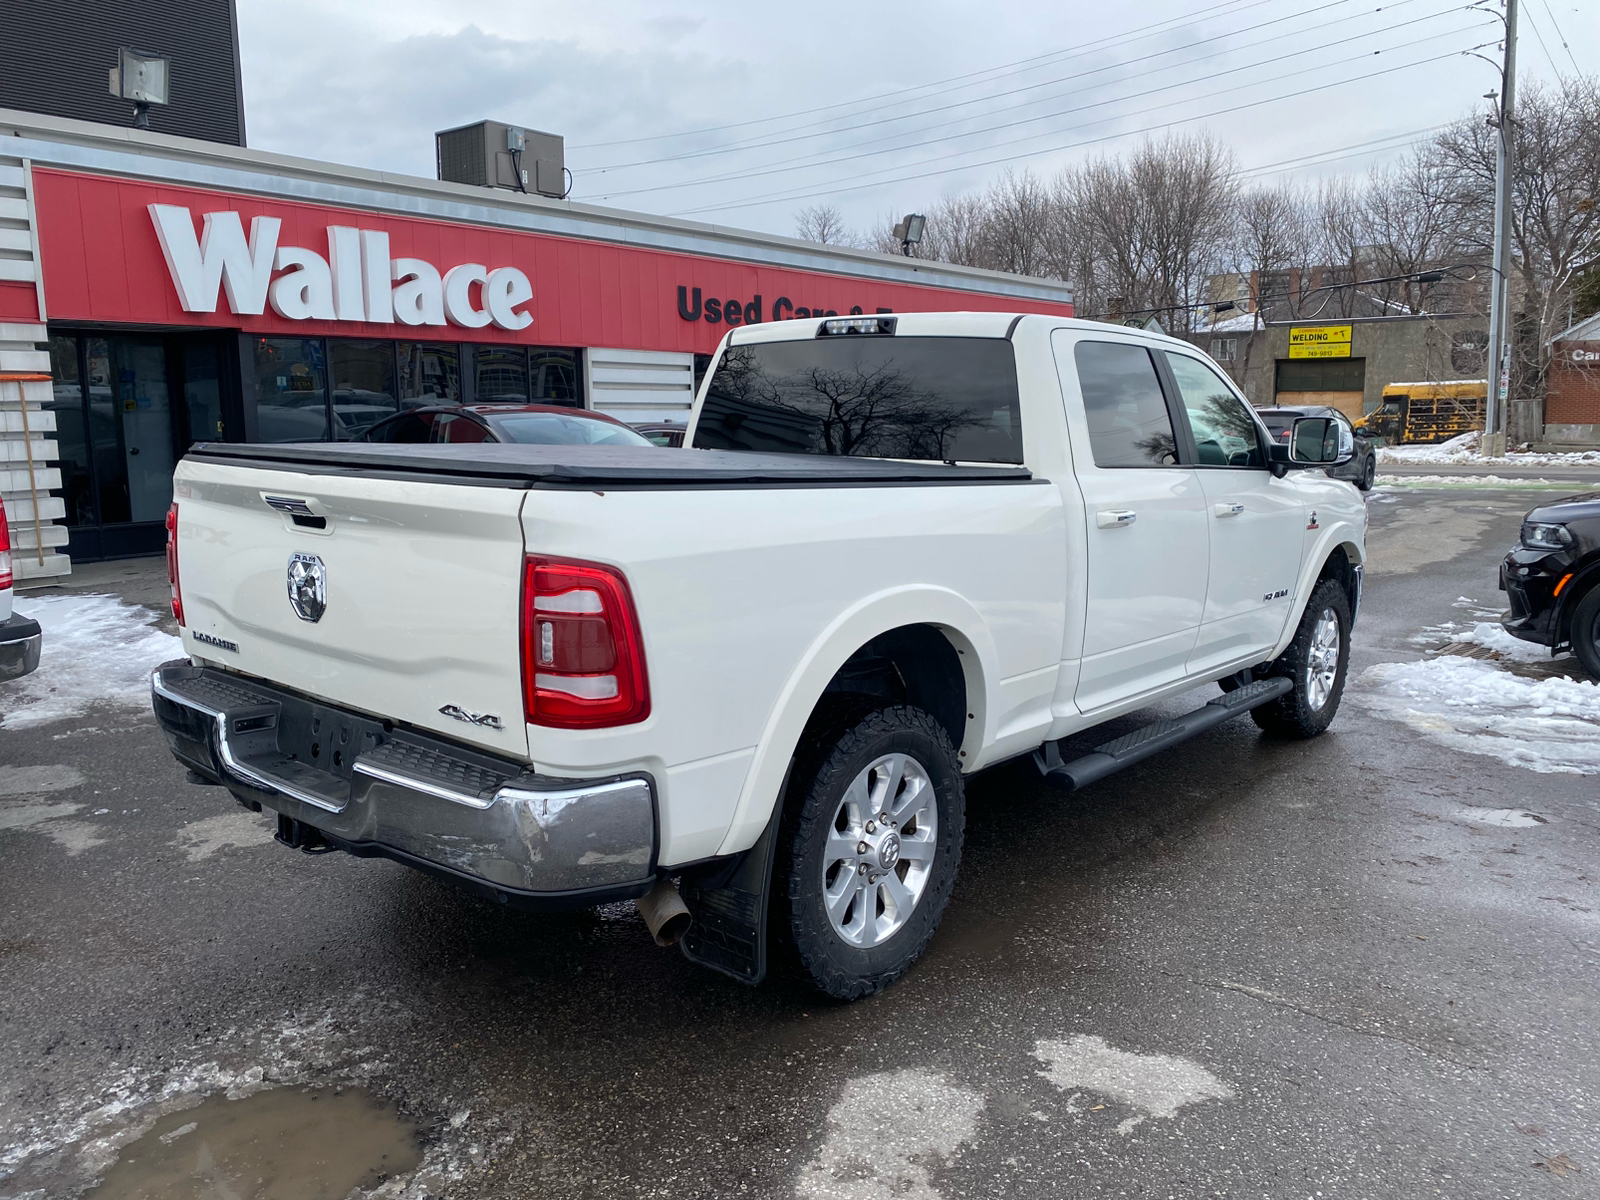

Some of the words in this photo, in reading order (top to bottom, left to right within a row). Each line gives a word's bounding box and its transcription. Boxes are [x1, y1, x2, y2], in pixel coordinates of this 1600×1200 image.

[147, 203, 534, 330] Wallace
[677, 286, 763, 325] Used
[1292, 333, 1328, 341] WELDING
[294, 553, 316, 563] RAM
[1263, 589, 1288, 602] RAM
[192, 630, 240, 654] LARAMIE
